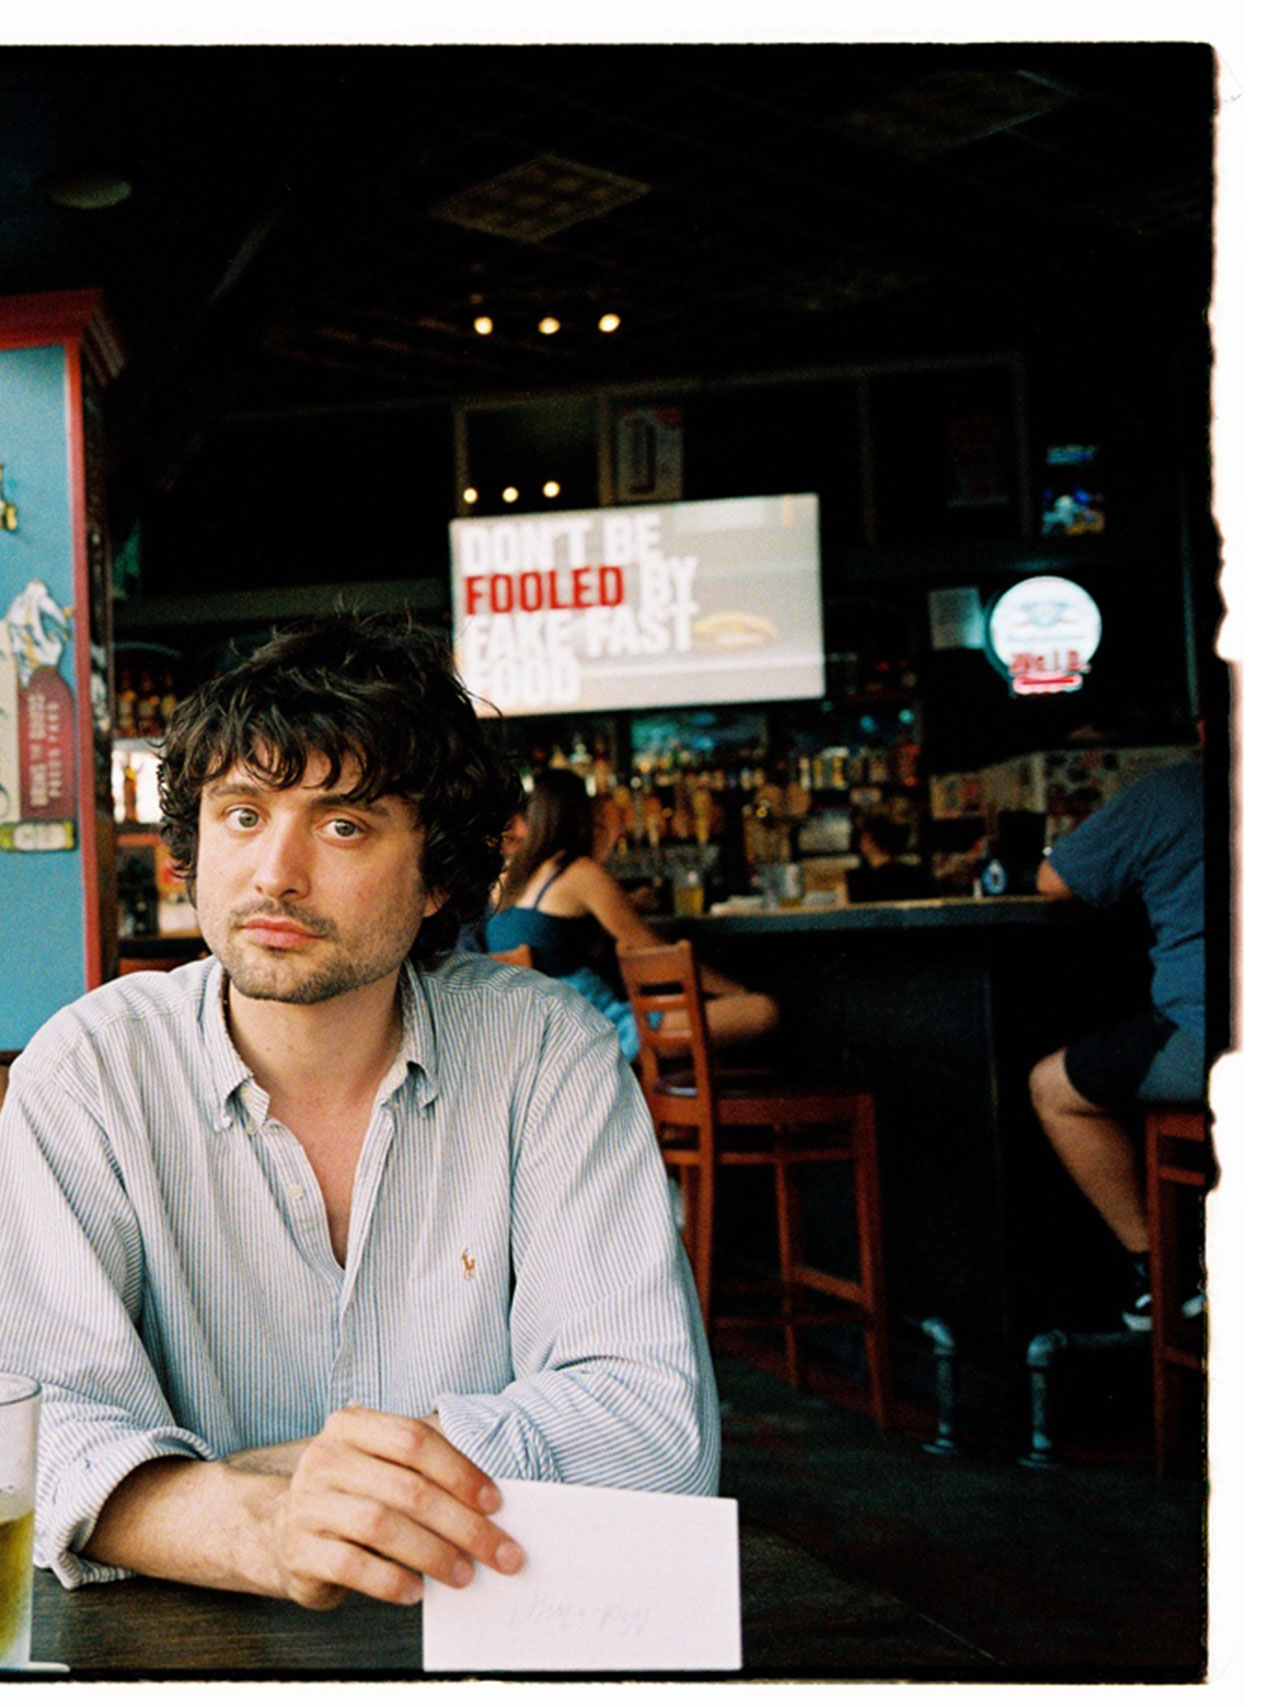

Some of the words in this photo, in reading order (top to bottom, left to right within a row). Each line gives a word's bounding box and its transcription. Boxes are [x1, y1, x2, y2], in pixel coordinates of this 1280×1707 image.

[458, 515, 593, 572] DON'T
[602, 511, 663, 567] BE
[464, 566, 625, 614] FOOLED
[640, 554, 699, 606] BY
[470, 611, 570, 664] FAKE
[585, 602, 699, 657] FAST
[472, 656, 581, 706] FOOD
